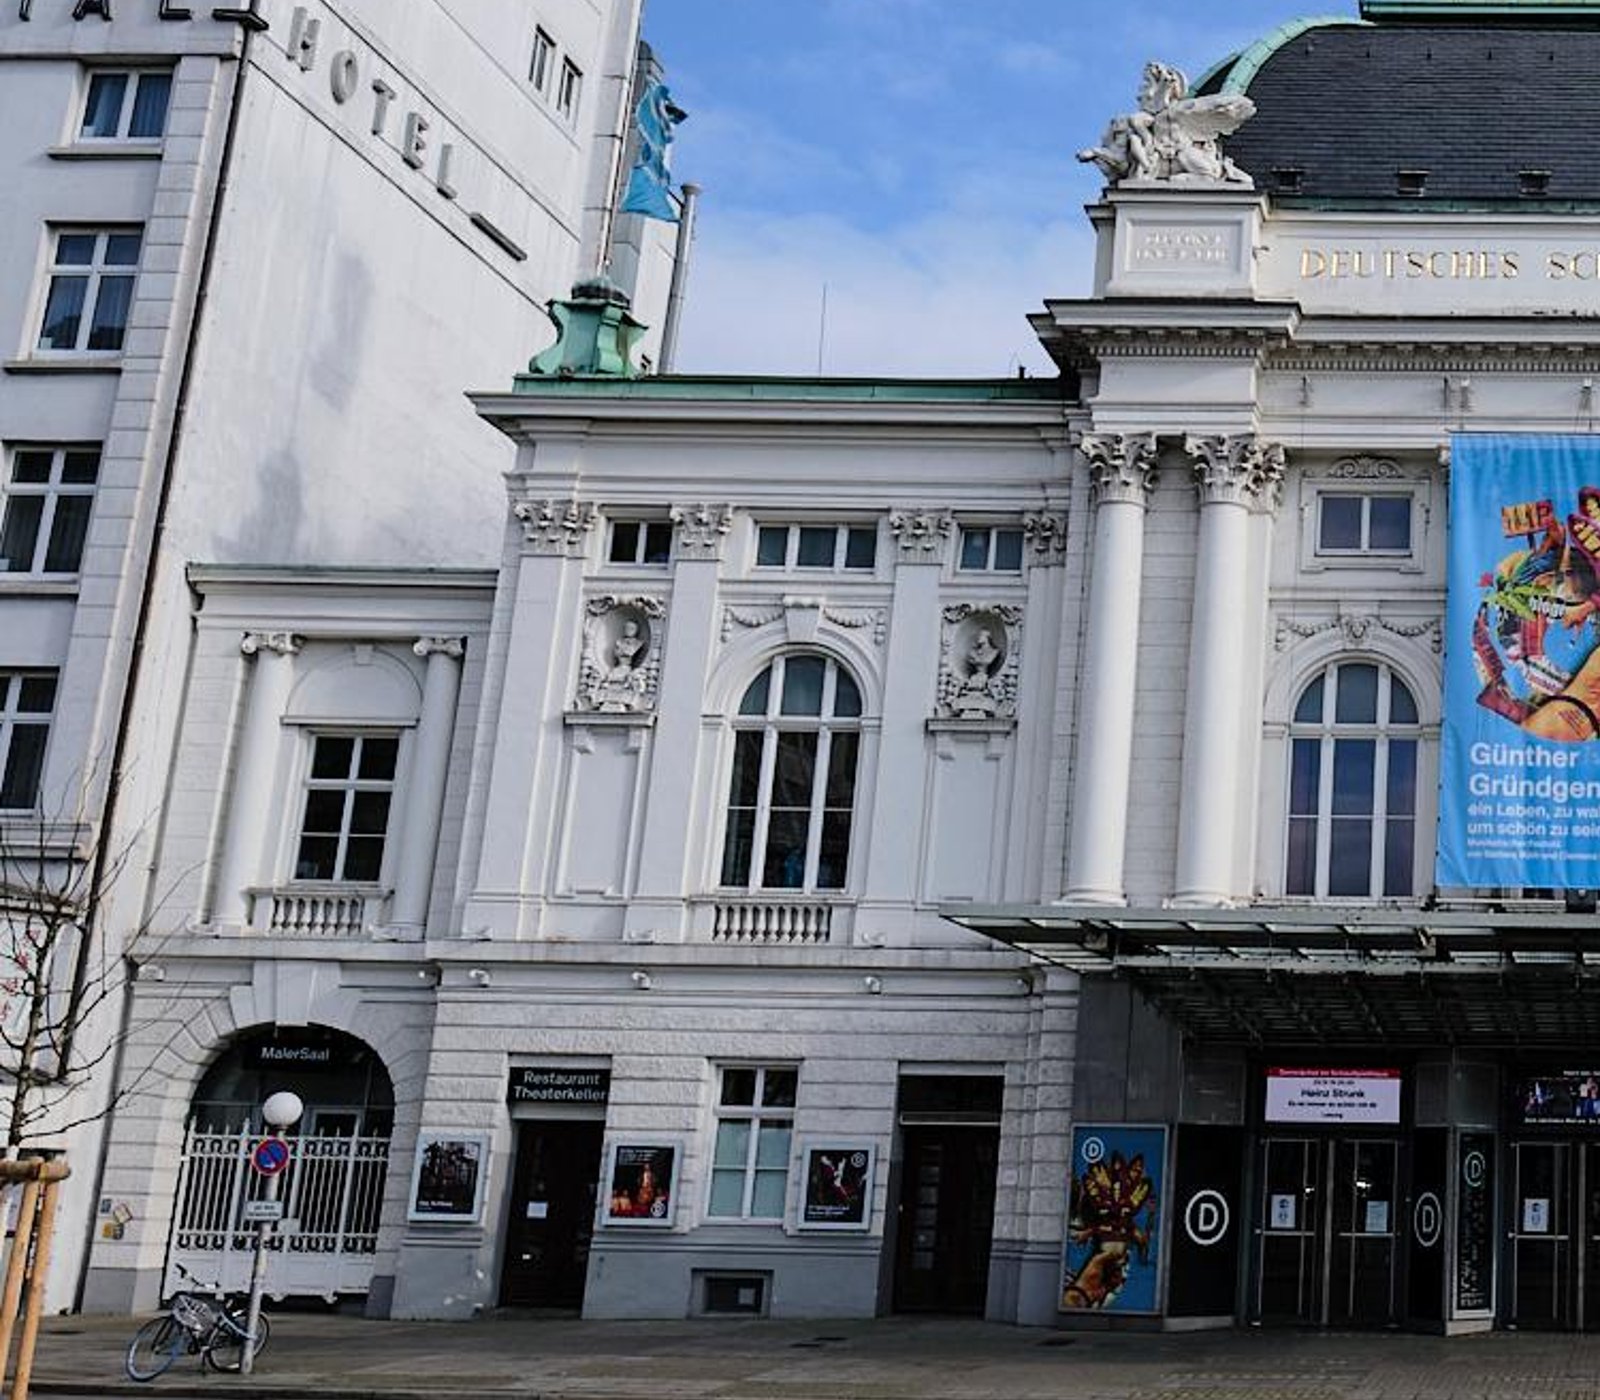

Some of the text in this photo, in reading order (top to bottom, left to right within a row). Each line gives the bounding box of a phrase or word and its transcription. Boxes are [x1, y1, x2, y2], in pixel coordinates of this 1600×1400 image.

[286, 7, 458, 200] HOTEL
[1301, 251, 1519, 279] DEUTSCHES
[1470, 742, 1580, 767] Günther
[1467, 803, 1492, 817] ein
[1497, 804, 1550, 820] Leben,
[1553, 806, 1572, 818] zu
[1467, 822, 1493, 834] um
[1497, 821, 1546, 836] schön
[1550, 824, 1568, 836] zu
[261, 1047, 330, 1060] MalerSaal
[524, 1071, 600, 1085] Restaurant
[514, 1085, 605, 1099] Theaterkeller
